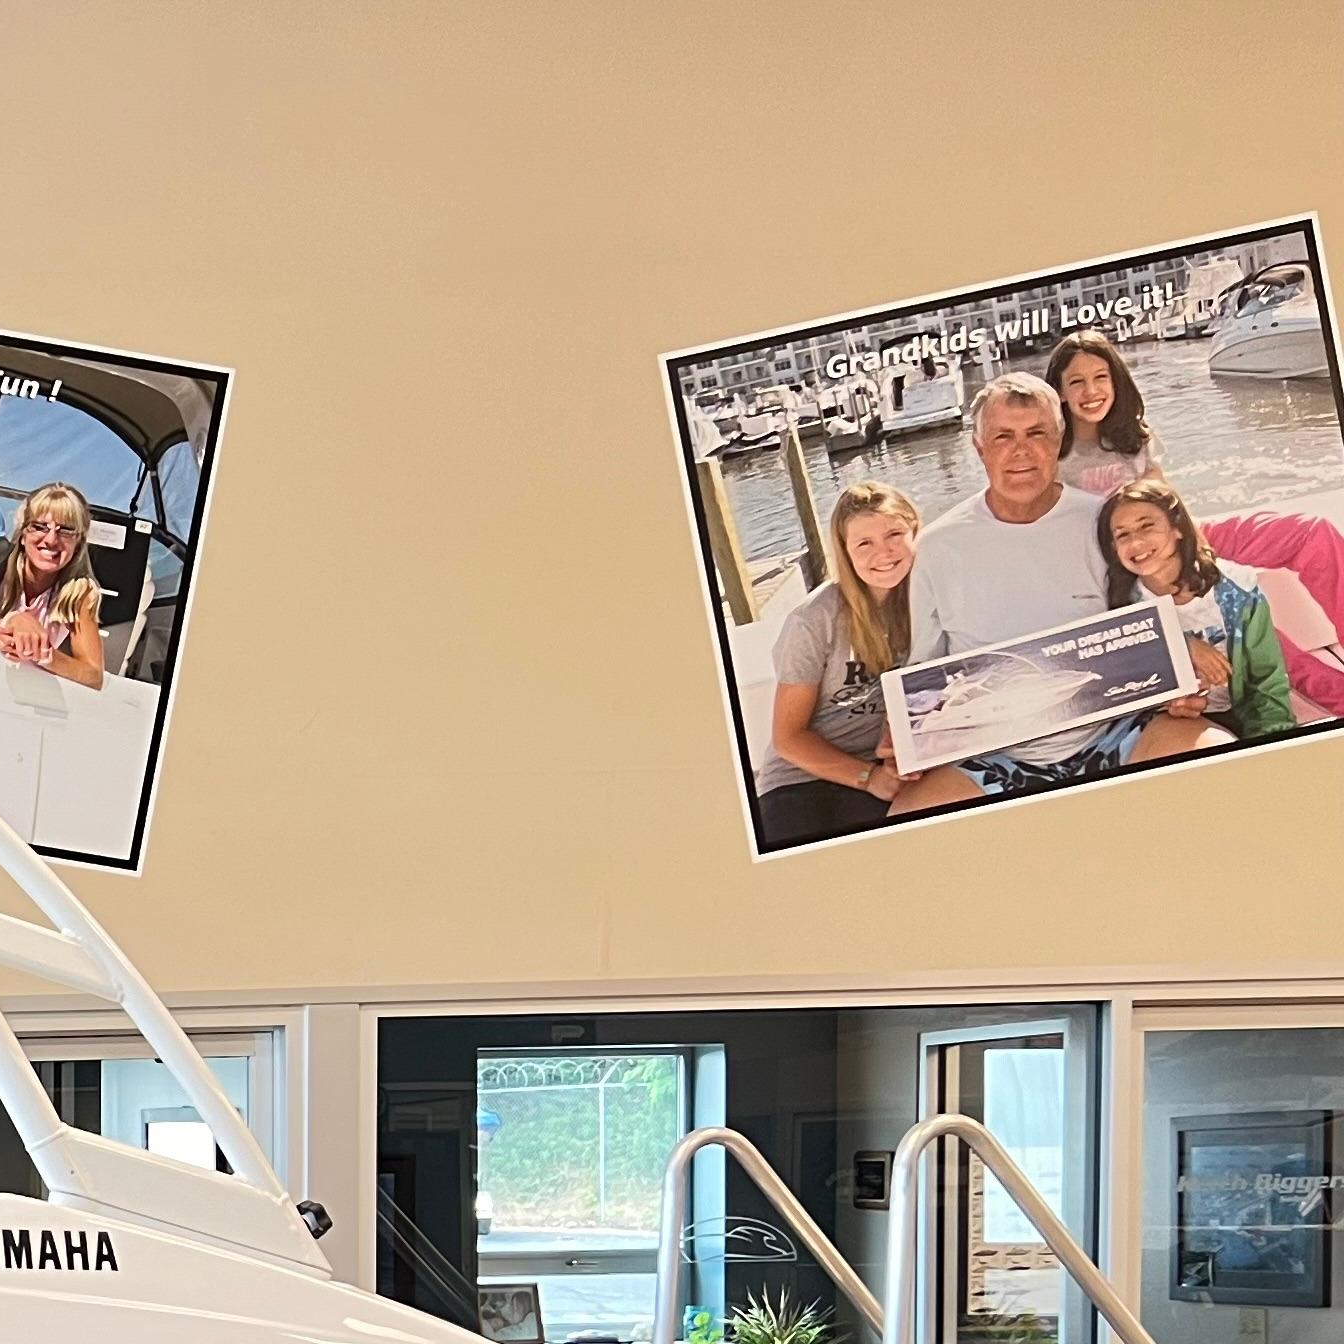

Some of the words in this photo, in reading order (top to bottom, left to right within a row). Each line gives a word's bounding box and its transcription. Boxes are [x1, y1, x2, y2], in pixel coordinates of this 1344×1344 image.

[826, 326, 987, 379] Grandkids
[995, 308, 1049, 342] will
[1061, 294, 1139, 329] Love
[1143, 282, 1174, 311] it!
[48, 379, 62, 402] !
[1041, 640, 1077, 657] YOUR
[1077, 627, 1122, 648] DREAM
[1122, 617, 1154, 635] BOAT
[1078, 644, 1104, 660] HAS
[1254, 1173, 1344, 1194] Bigger
